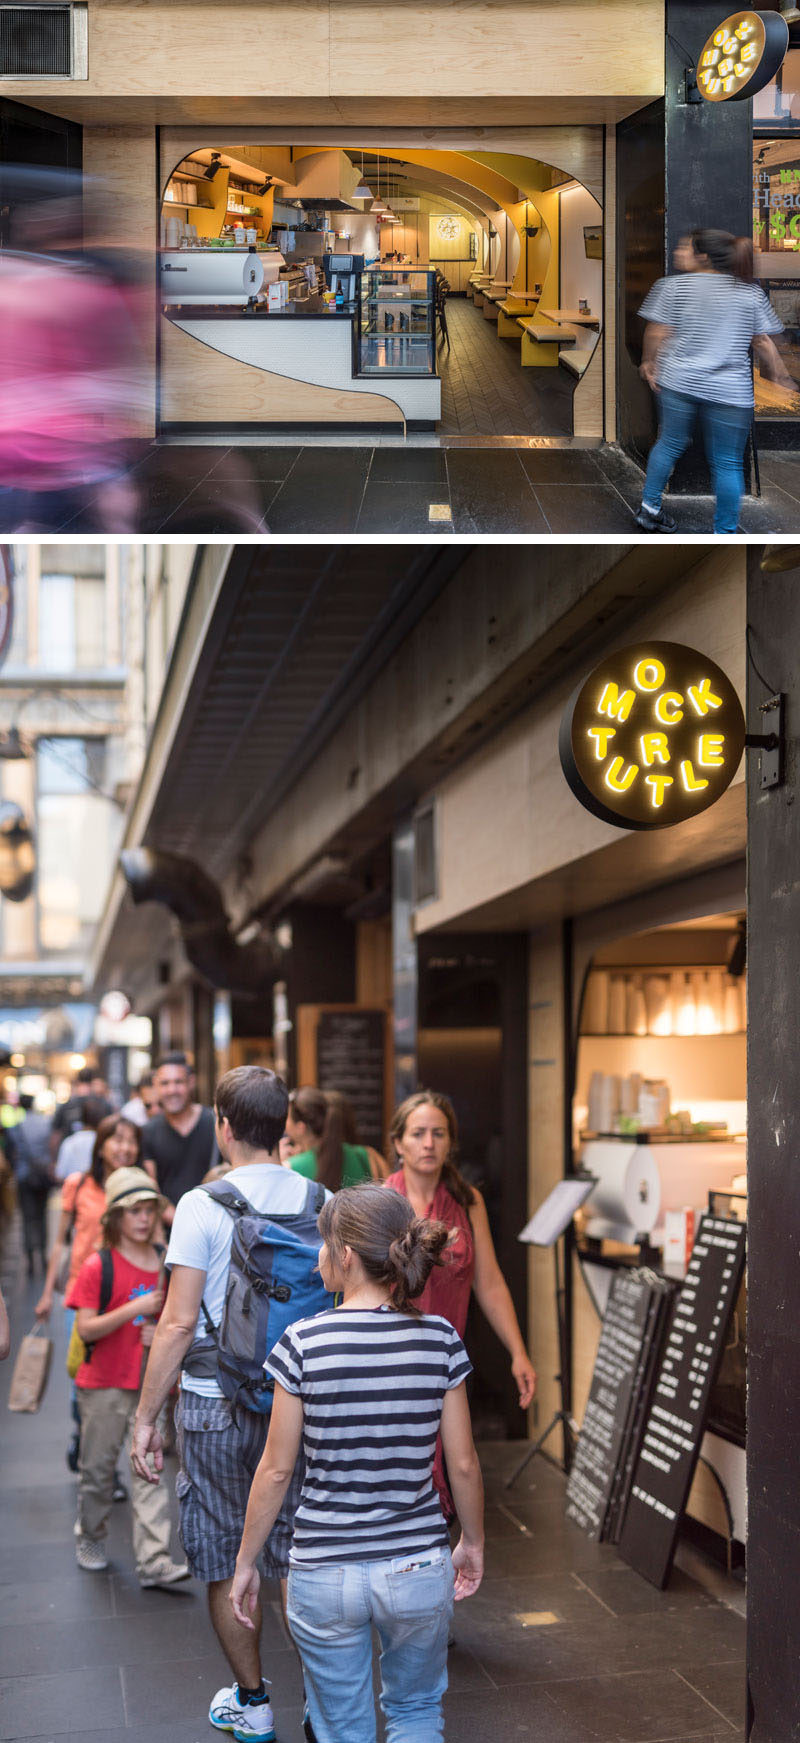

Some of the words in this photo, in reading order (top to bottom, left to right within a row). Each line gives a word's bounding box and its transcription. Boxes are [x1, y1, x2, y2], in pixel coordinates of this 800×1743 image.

[753, 171, 770, 183] ith
[597, 658, 723, 725] MOCK
[588, 727, 725, 808] TURTLE
